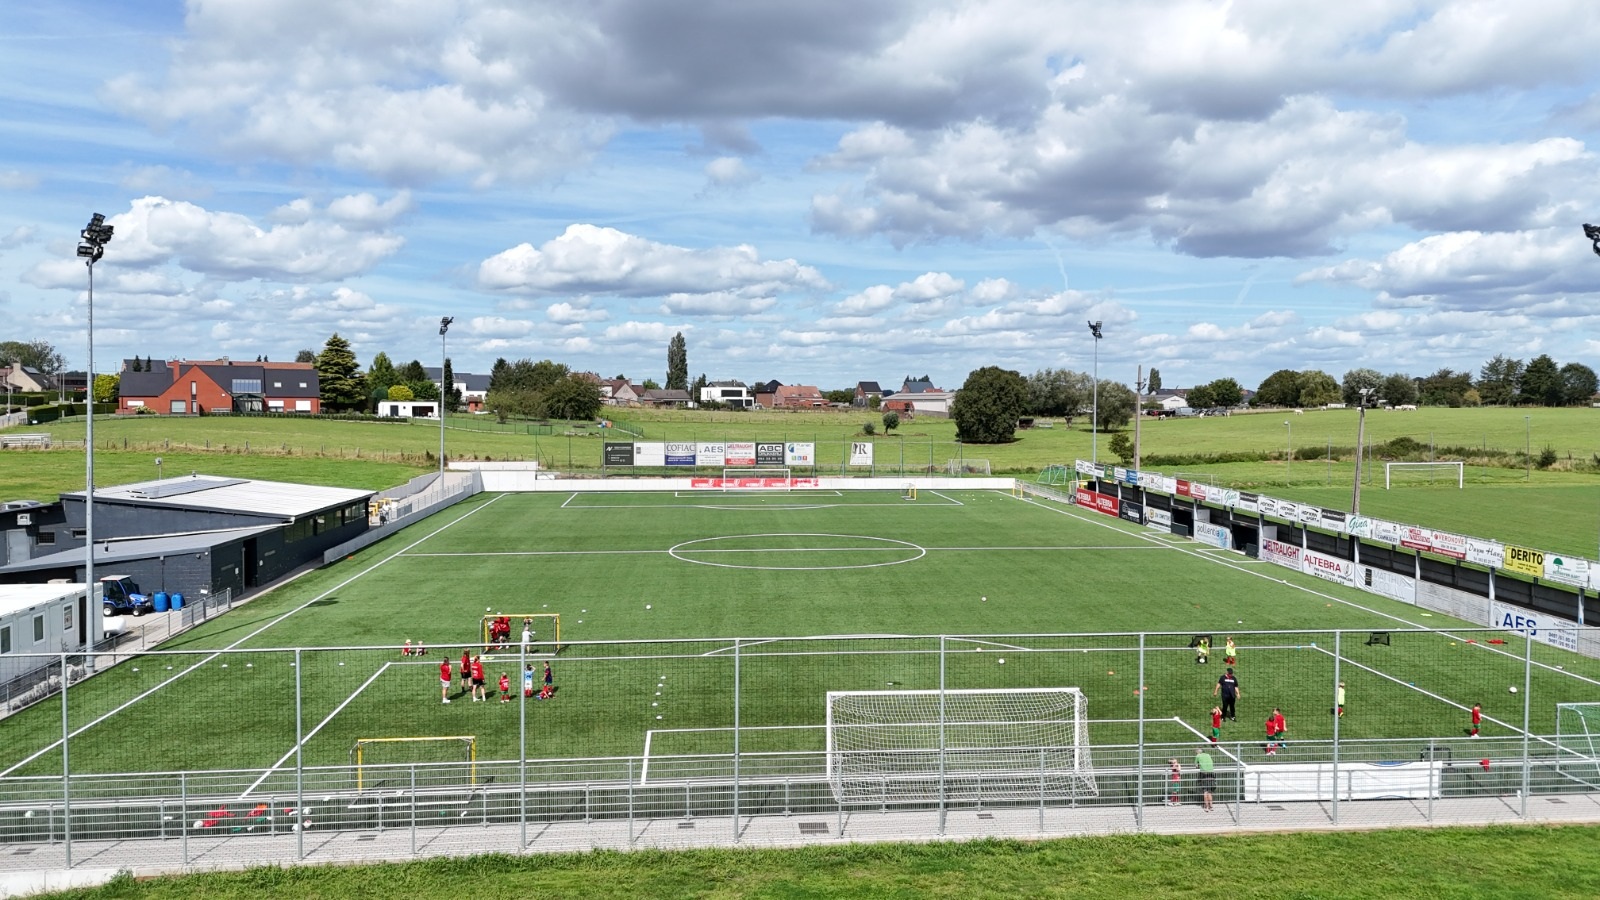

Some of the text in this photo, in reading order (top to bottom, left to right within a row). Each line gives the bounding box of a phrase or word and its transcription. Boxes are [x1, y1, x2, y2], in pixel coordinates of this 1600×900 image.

[704, 445, 724, 453] AES
[1304, 554, 1342, 573] ALTEBRA
[1511, 548, 1543, 565] DERITO
[1503, 612, 1537, 636] AES
